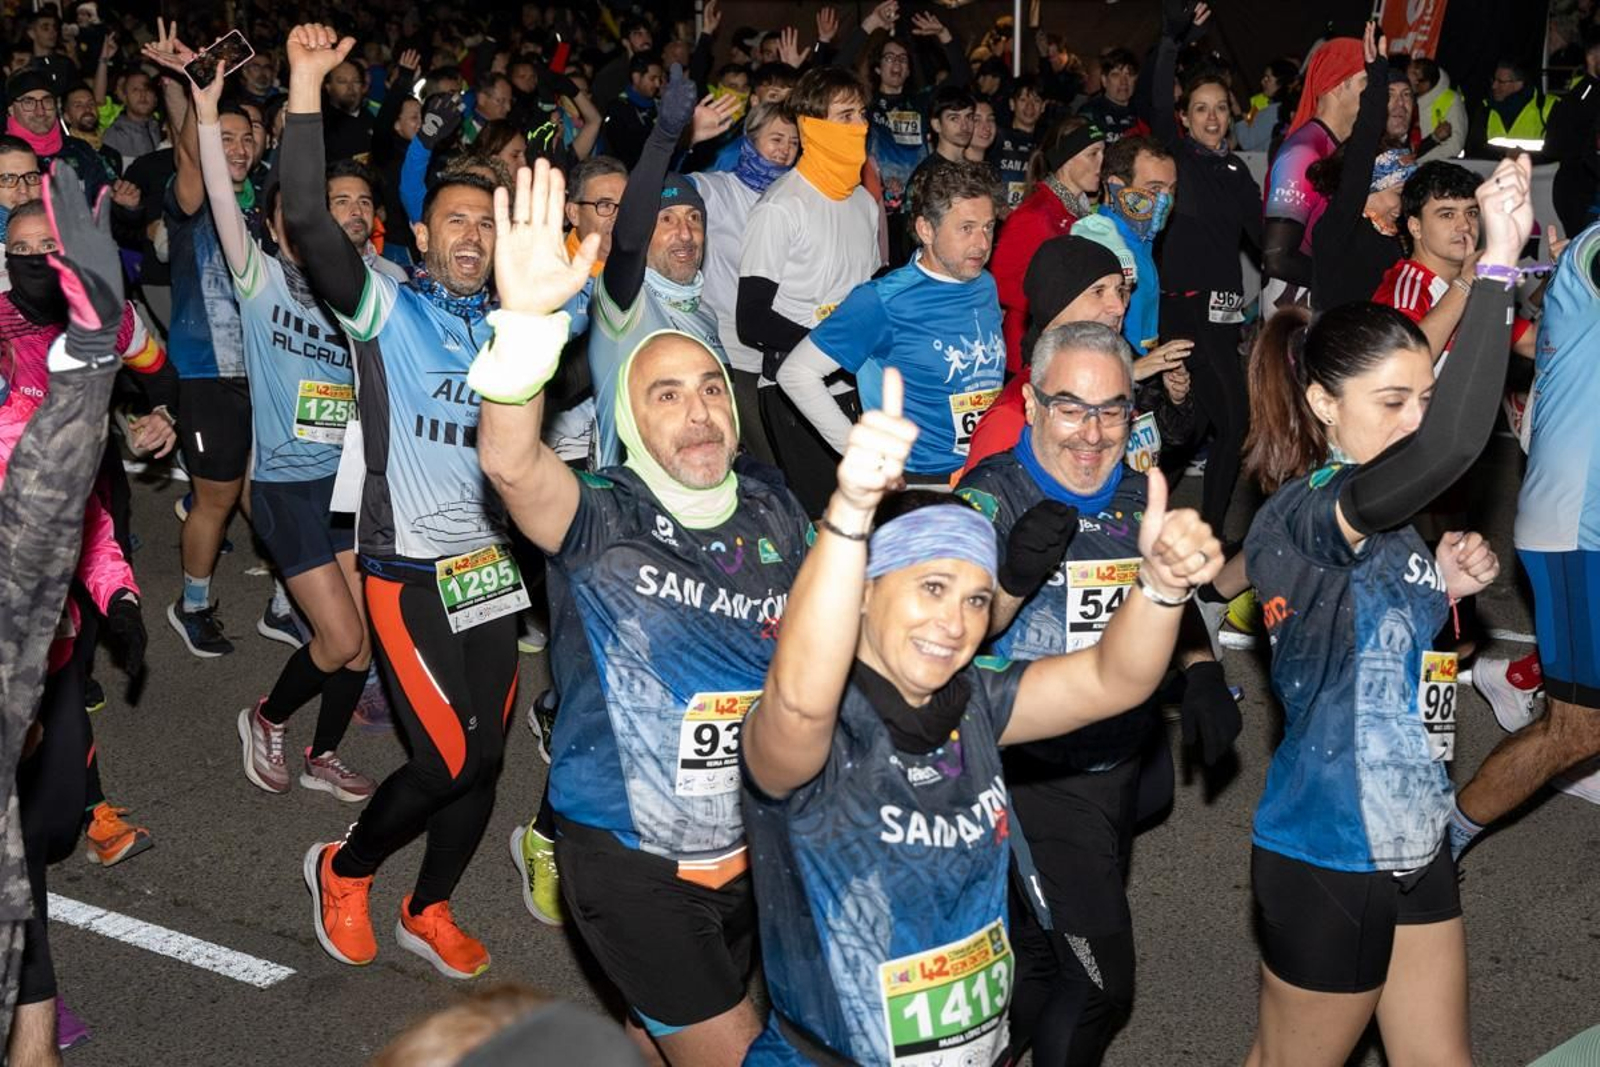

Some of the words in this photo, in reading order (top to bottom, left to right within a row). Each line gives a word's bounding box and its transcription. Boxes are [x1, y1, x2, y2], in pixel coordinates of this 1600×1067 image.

[1001, 160, 1021, 172] SAN
[447, 559, 515, 602] 1295
[636, 565, 706, 608] SAN
[1095, 565, 1117, 581] 42
[715, 697, 738, 715] 42
[880, 805, 958, 848] SAN
[919, 955, 950, 981] 42
[903, 961, 1009, 1039] 1413
